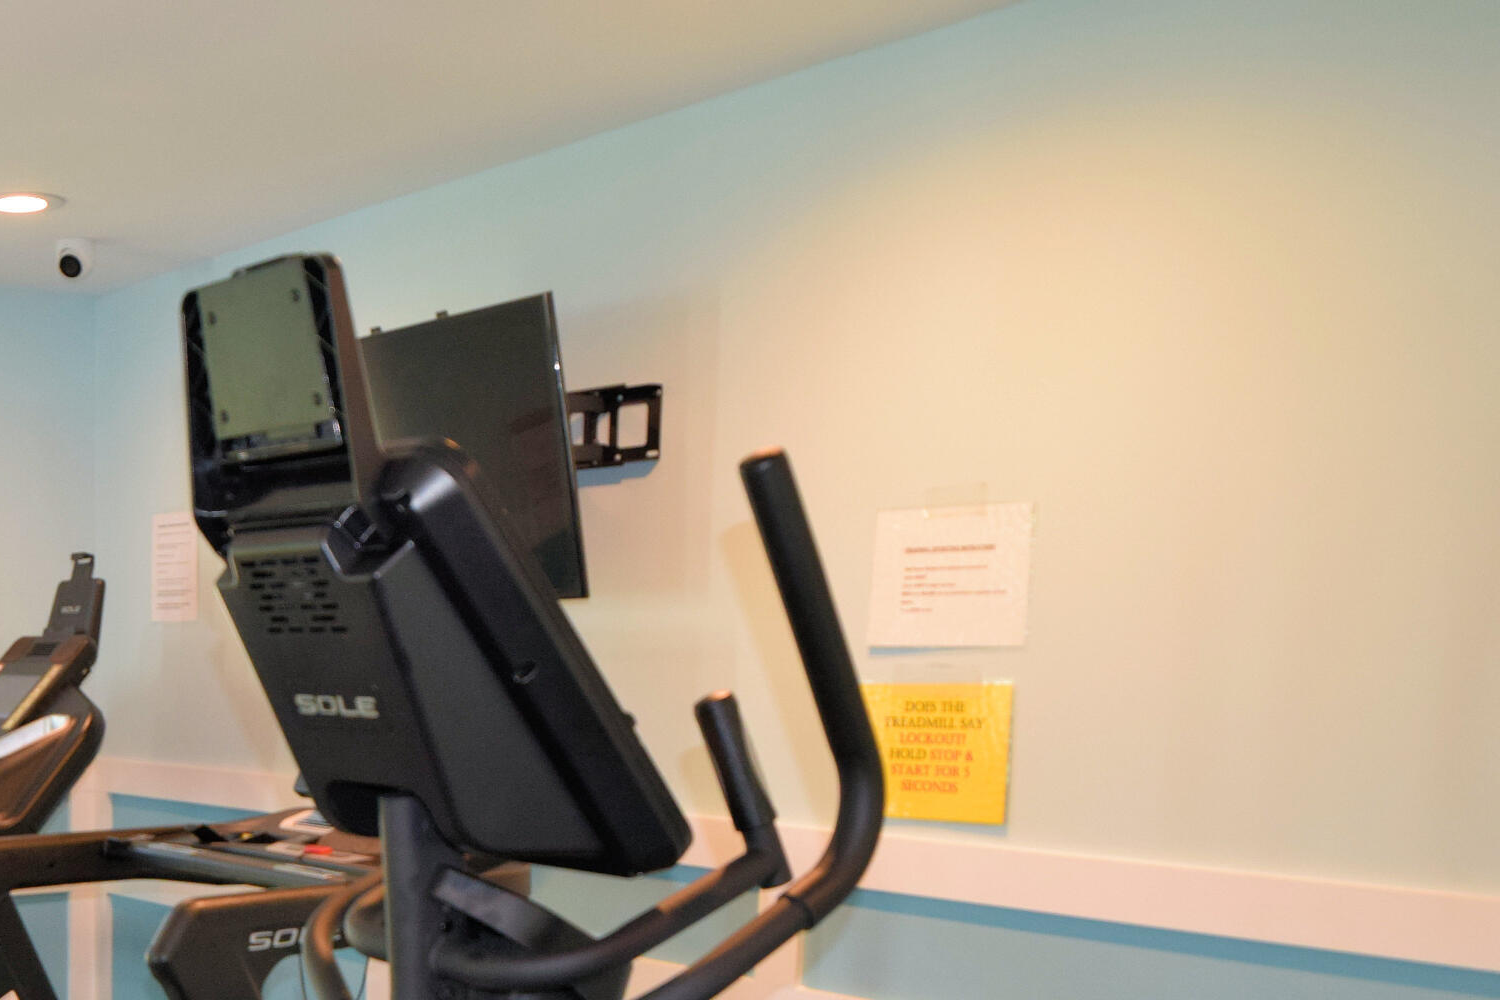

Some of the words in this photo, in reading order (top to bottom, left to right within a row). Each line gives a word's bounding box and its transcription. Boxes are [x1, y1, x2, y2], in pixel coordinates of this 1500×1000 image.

[294, 694, 379, 719] SOLE
[905, 700, 937, 713] DOES
[940, 701, 965, 713] THE
[884, 716, 957, 729] TREADMILL
[960, 717, 987, 729] SAY
[889, 747, 927, 760] HOLD
[930, 749, 962, 761] STOP
[890, 763, 930, 776] START
[935, 764, 960, 777] FOR
[901, 779, 958, 793] SECONDS
